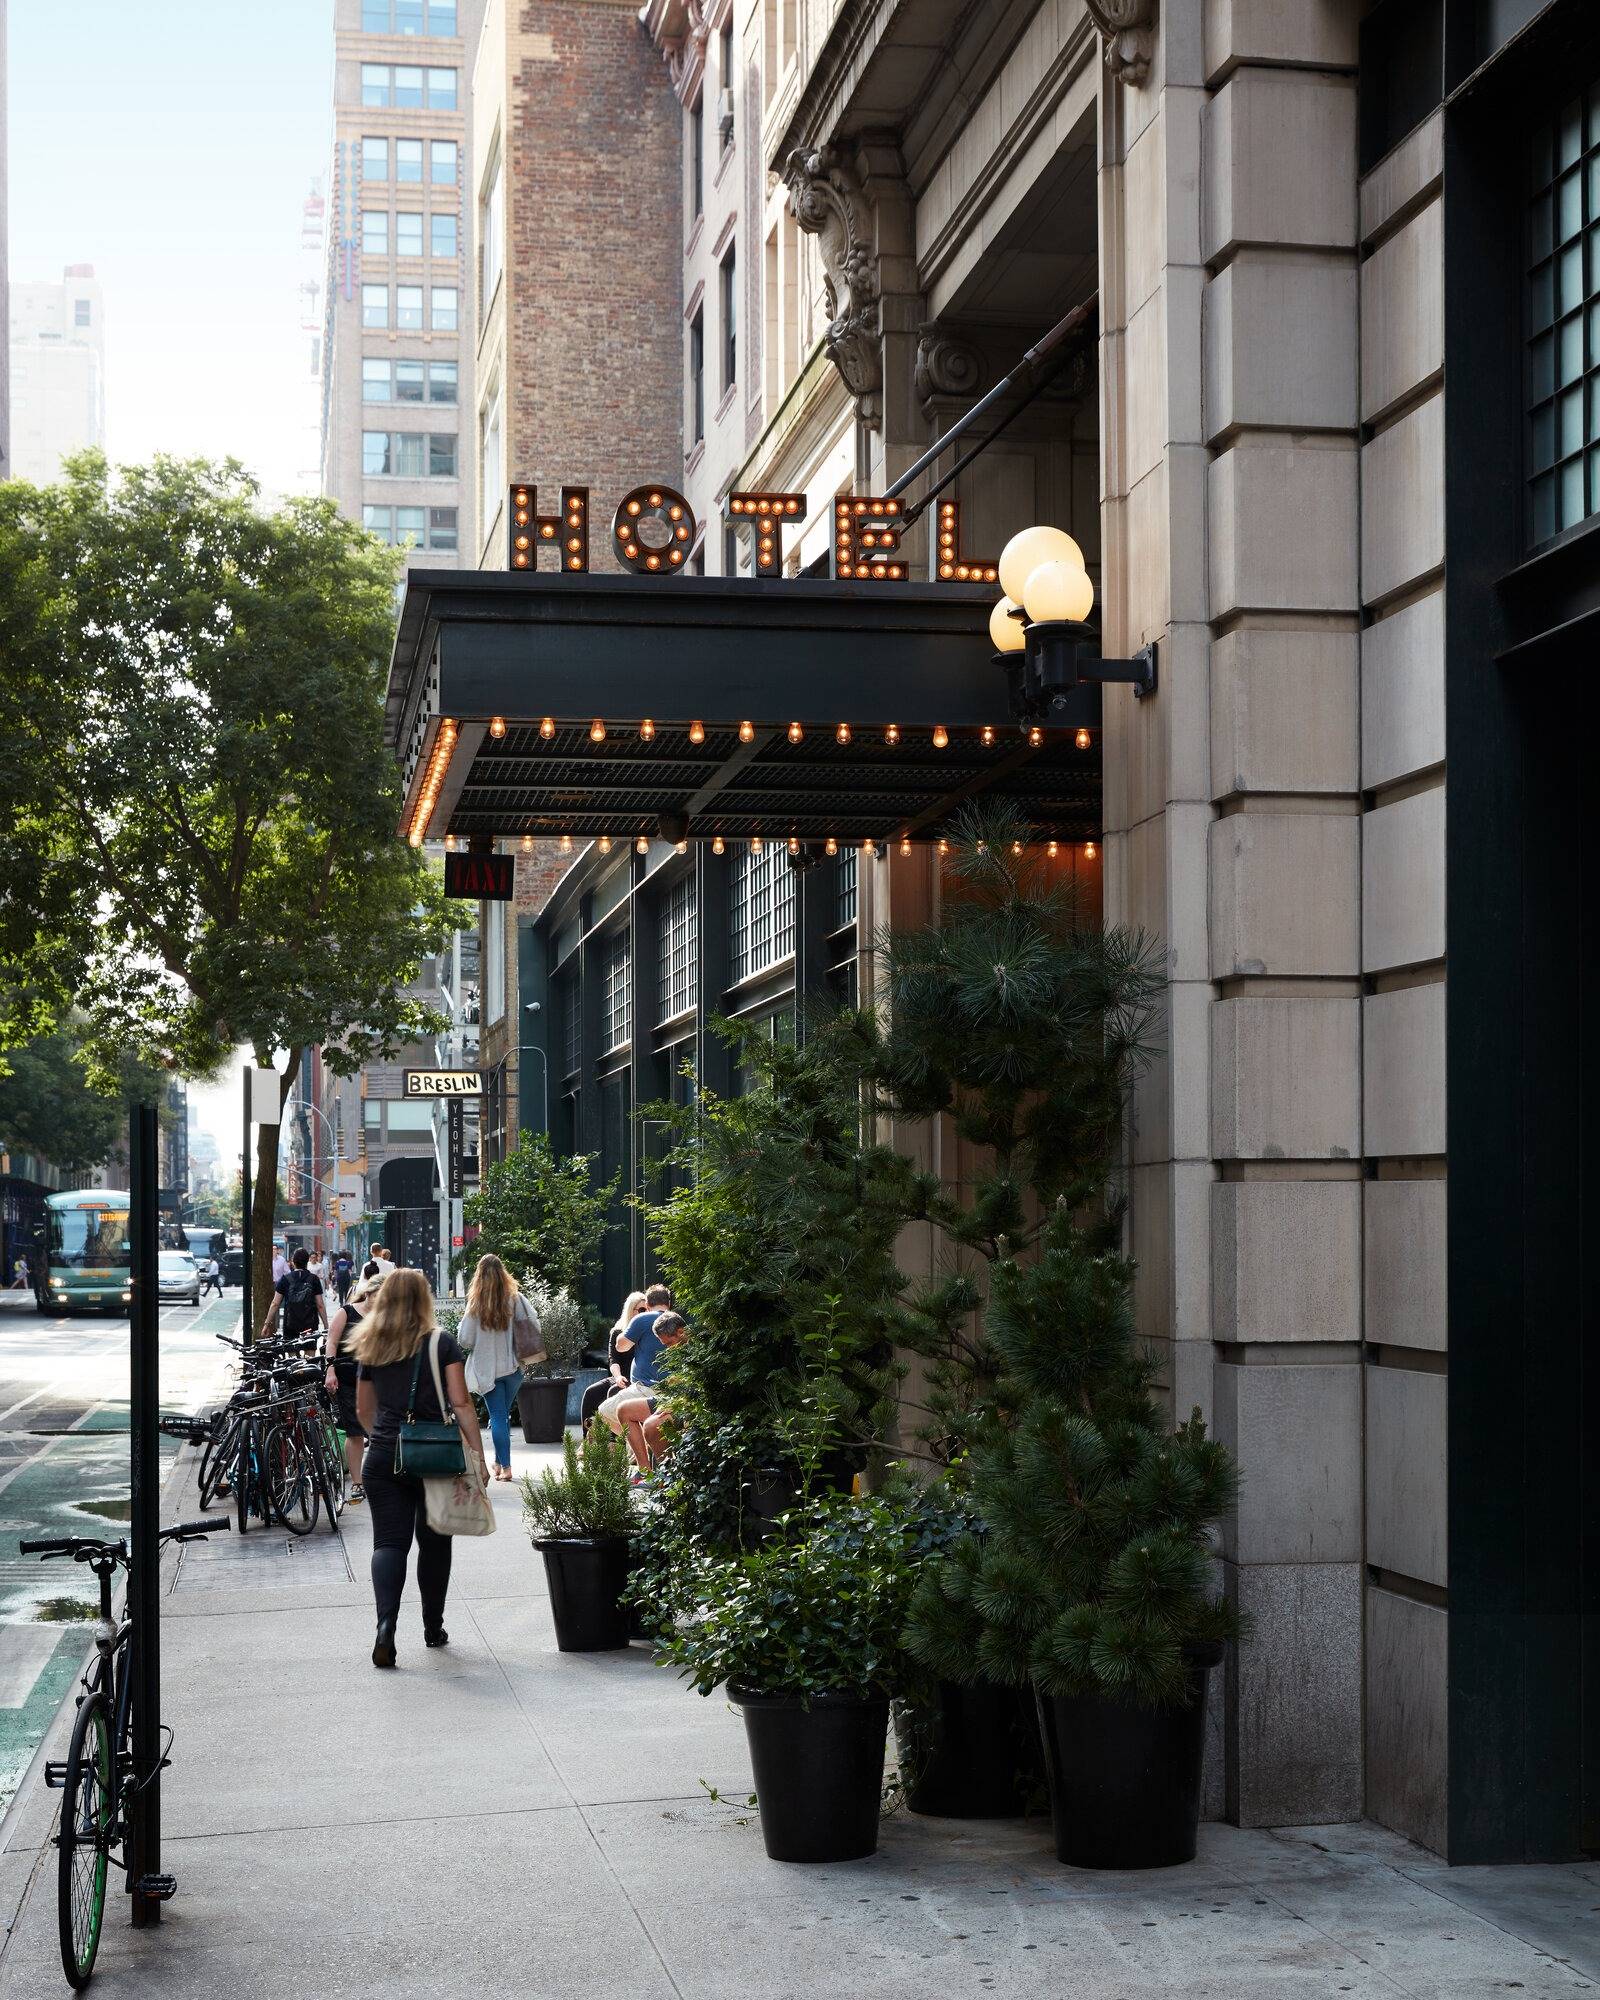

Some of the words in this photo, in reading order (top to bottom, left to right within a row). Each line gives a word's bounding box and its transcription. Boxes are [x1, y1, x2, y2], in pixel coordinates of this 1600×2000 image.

[509, 483, 999, 582] HOTEL
[451, 860, 508, 893] TAXI
[410, 1074, 477, 1092] BRESLIN
